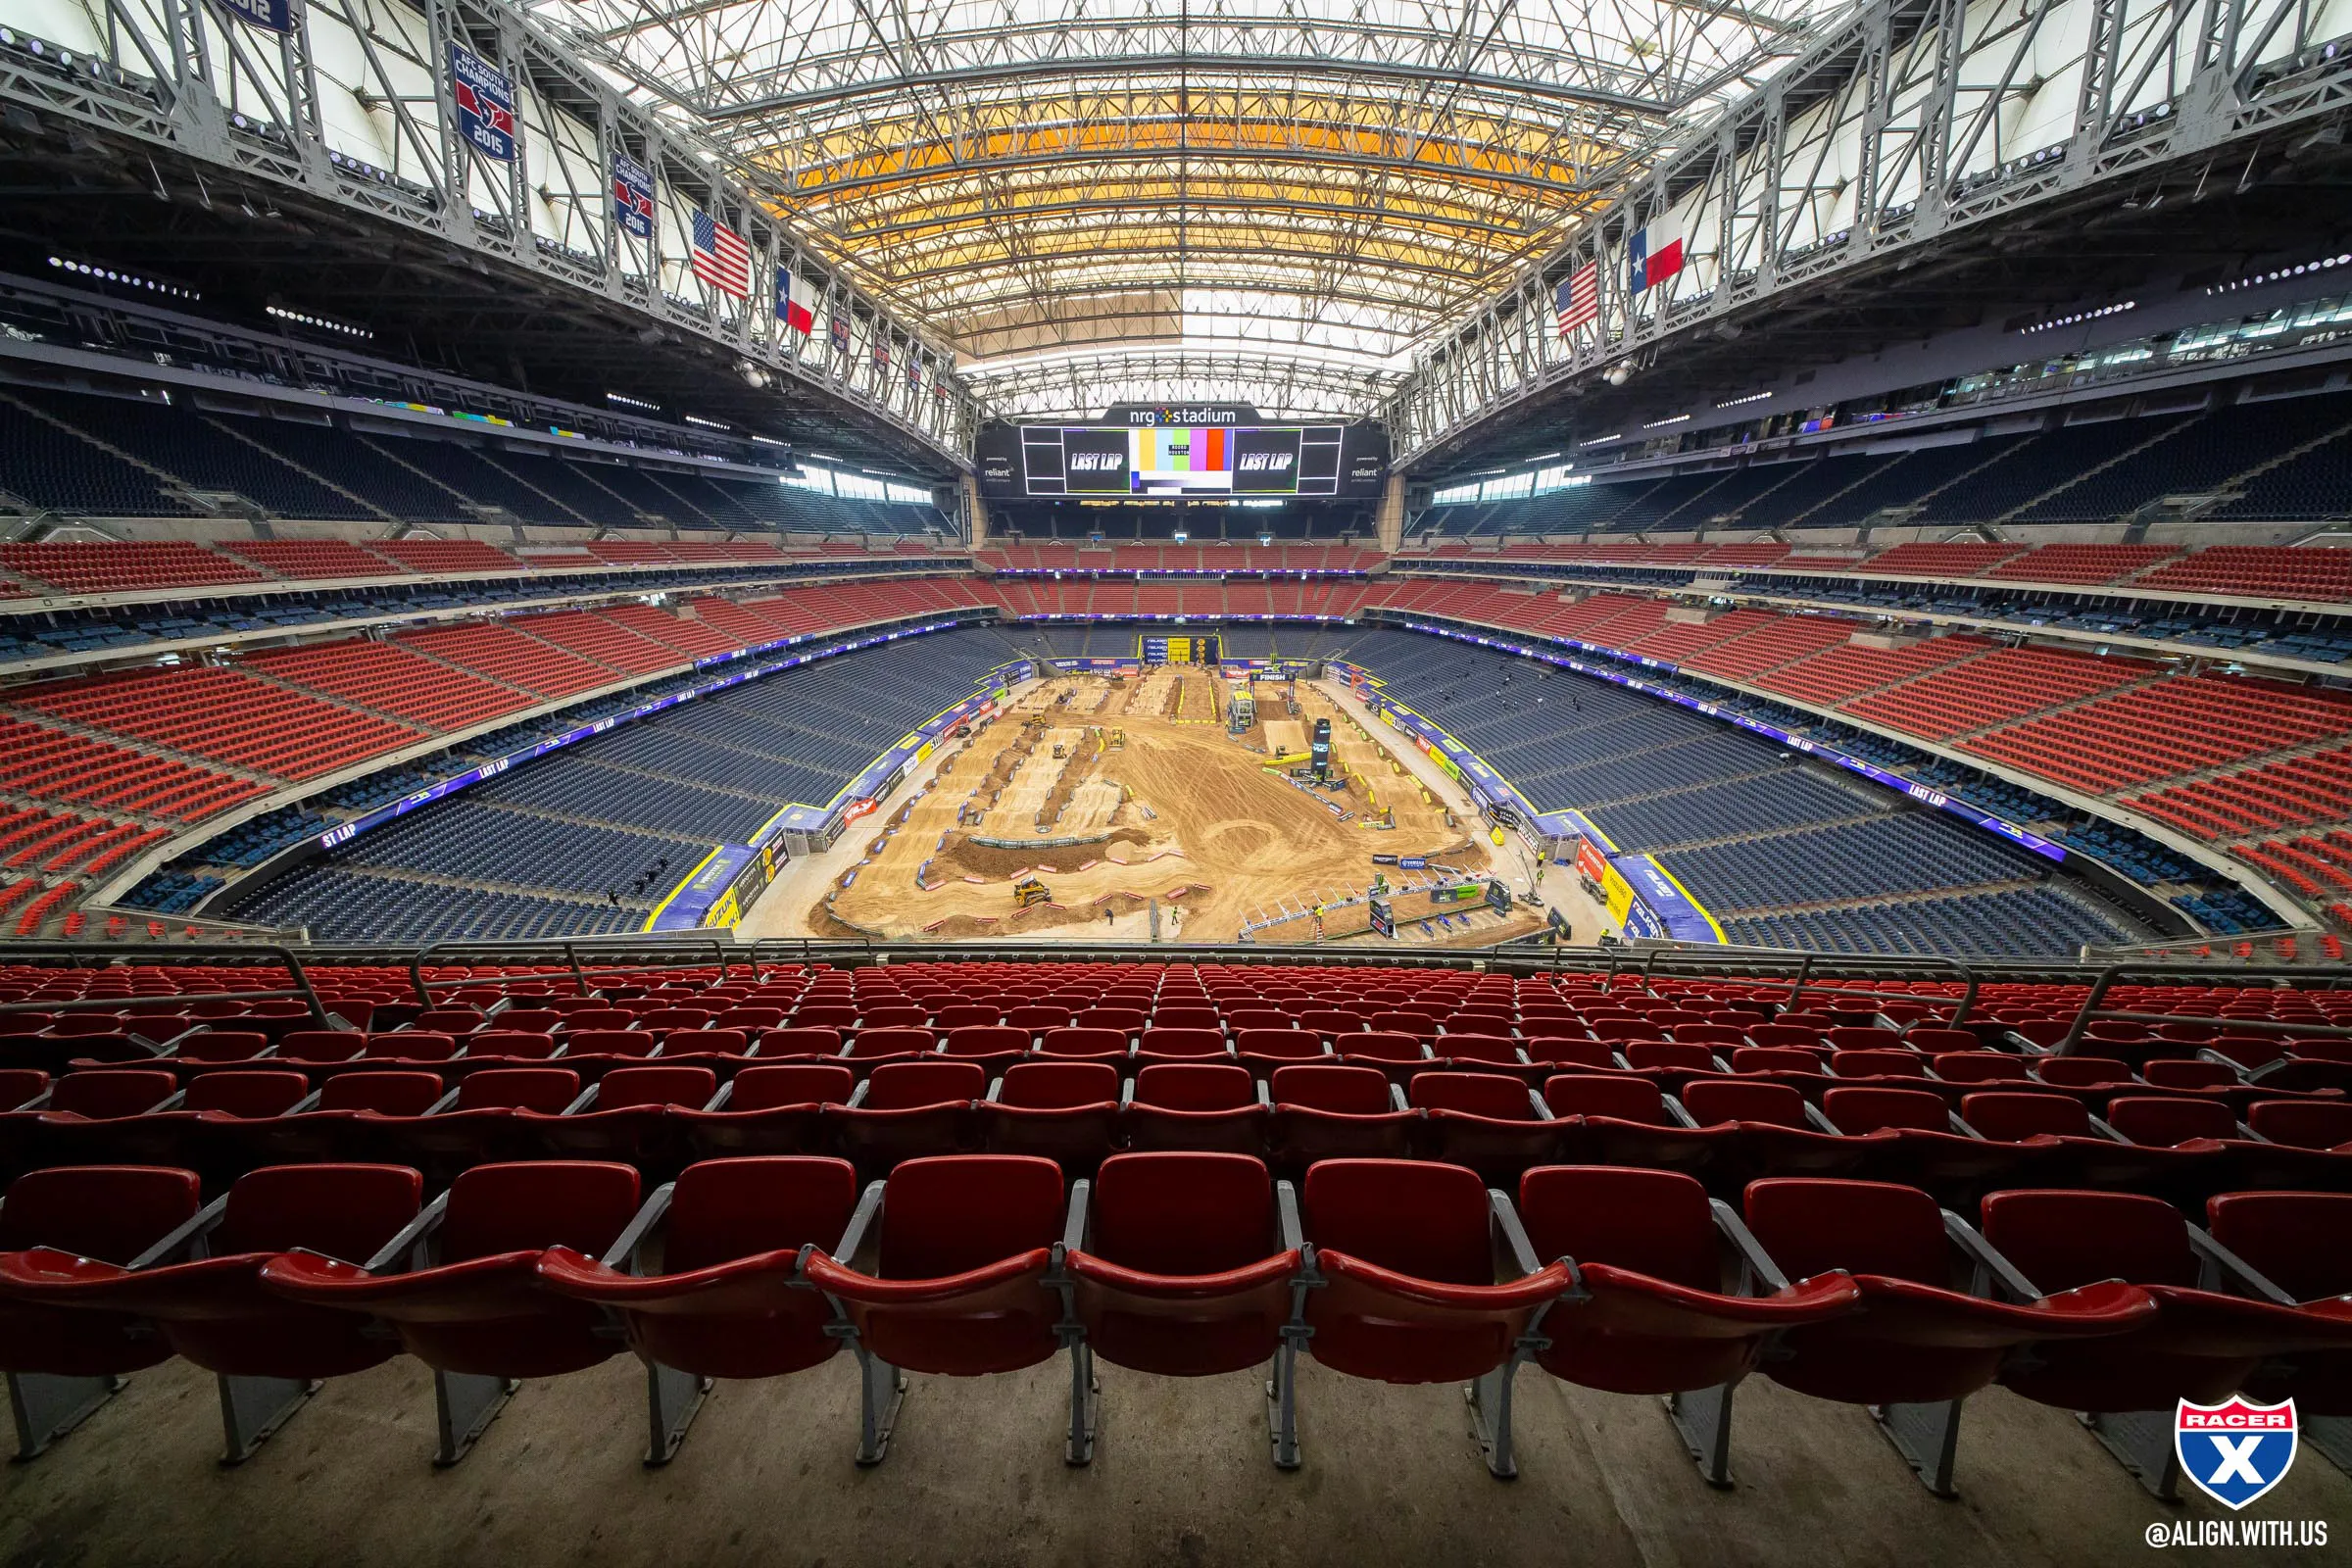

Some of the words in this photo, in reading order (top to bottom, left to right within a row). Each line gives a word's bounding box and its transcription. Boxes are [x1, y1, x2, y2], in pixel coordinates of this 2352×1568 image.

[462, 53, 476, 71] AFC
[478, 64, 504, 88] SOUTH
[456, 60, 510, 104] CHAMPIONS
[473, 125, 504, 155] 2015
[615, 165, 652, 193] CHAMPIONS
[631, 167, 648, 182] SOUTH
[625, 213, 645, 234] 2016
[1130, 411, 1155, 426] nrg
[1172, 408, 1236, 423] stadium
[1071, 453, 1100, 470] LAST
[1100, 453, 1123, 470] LAP
[1239, 453, 1269, 470] LAST
[1269, 453, 1293, 470] LAP
[985, 467, 1010, 477] reliant
[1351, 467, 1378, 477] reliant
[593, 721, 606, 733] LAST
[606, 717, 614, 728] LAP
[1787, 735, 1802, 749] LAST
[1801, 739, 1813, 752] LAP
[478, 762, 496, 779] LAST
[496, 759, 510, 772] LAP
[1909, 784, 1930, 803] LAST
[1930, 790, 1946, 808] LAP
[337, 824, 357, 842] LAP
